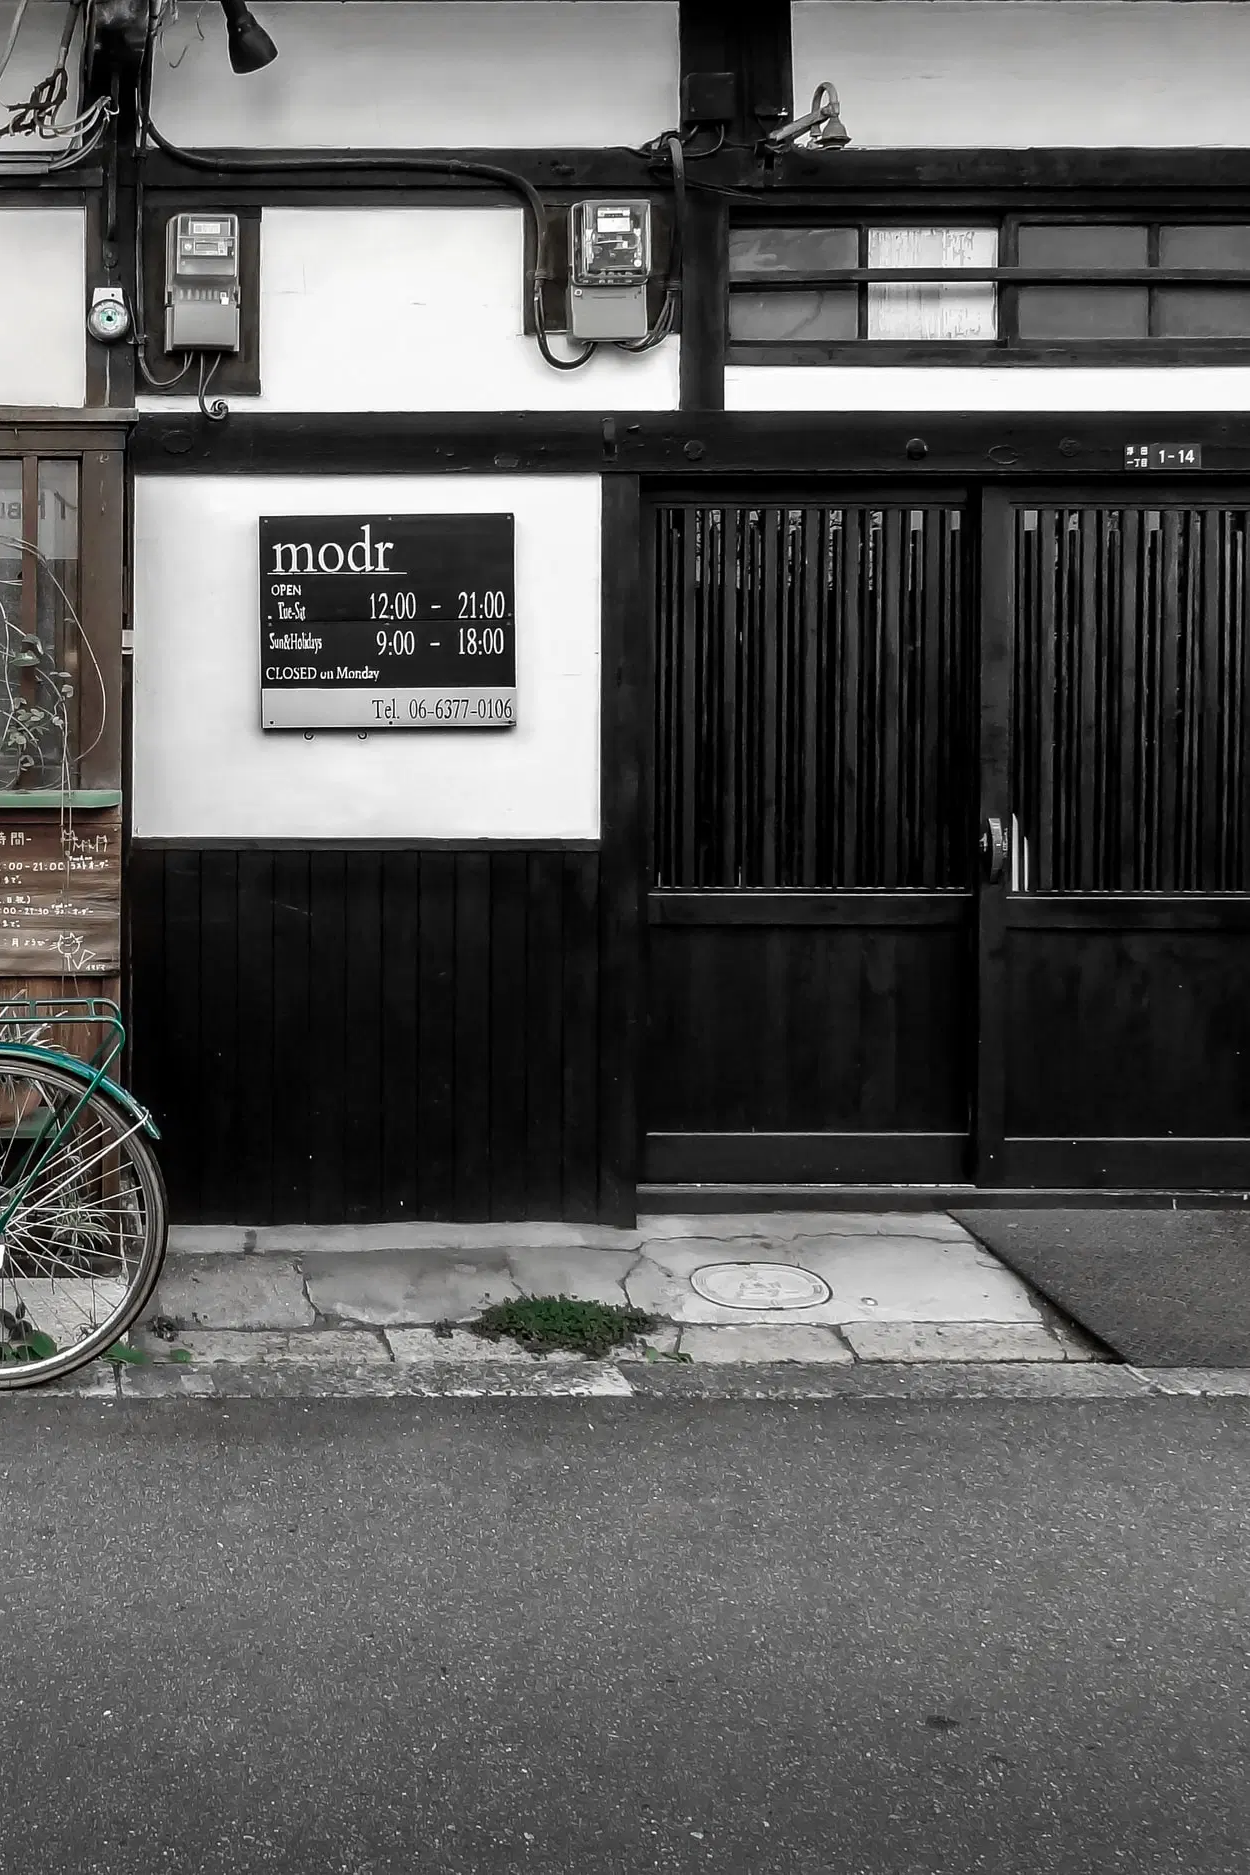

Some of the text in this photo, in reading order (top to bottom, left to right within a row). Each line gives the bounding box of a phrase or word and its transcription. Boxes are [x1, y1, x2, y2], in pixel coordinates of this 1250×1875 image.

[1158, 449, 1195, 463] 1-14
[272, 524, 394, 573] modr
[271, 584, 302, 596] OPEN
[369, 592, 416, 620] 12:00
[458, 591, 505, 619] 21:00
[269, 632, 322, 654] Sun&Holidays
[376, 631, 415, 656] 9:00
[459, 628, 504, 655] 18:00
[266, 666, 379, 682] CLOSED on Monday
[372, 699, 512, 719] Tel. 06-6377-0106
